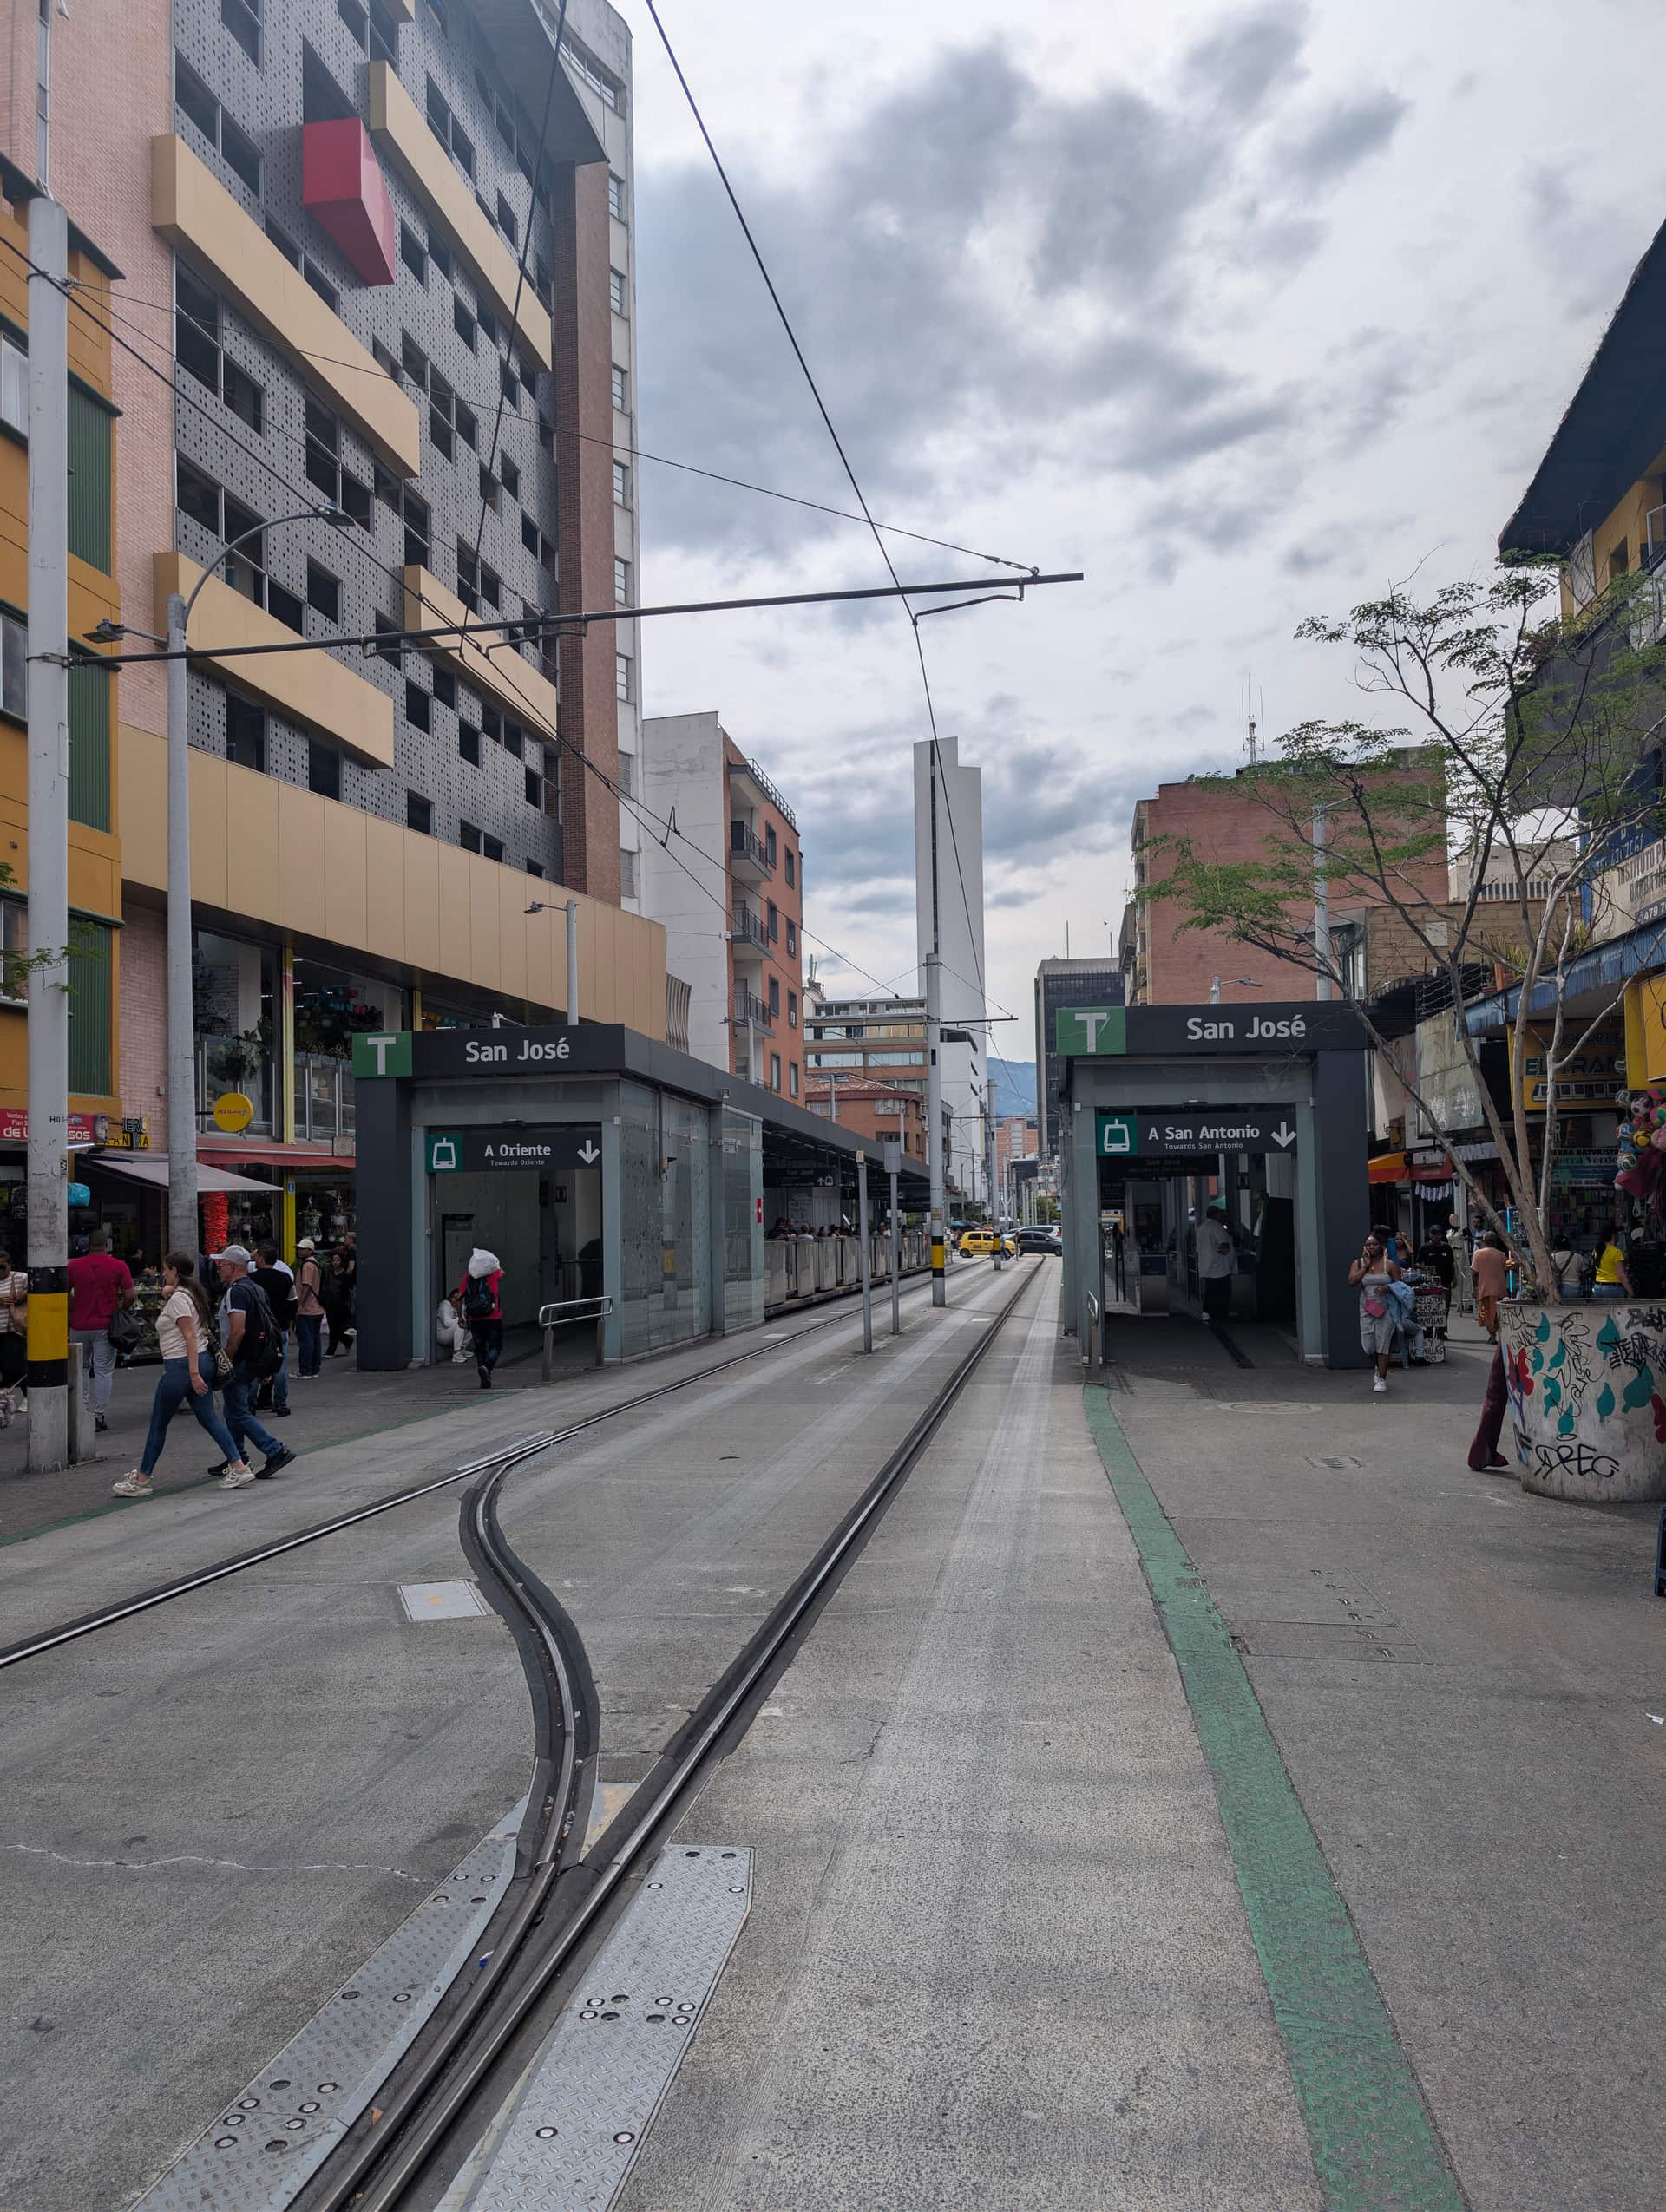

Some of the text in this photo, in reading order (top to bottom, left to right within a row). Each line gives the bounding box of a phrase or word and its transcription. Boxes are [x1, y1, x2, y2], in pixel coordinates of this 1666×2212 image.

[1618, 843, 1663, 887] INSTITUTO P
[1643, 905, 1659, 920] 479
[1075, 1012, 1109, 1053] T
[1186, 1013, 1307, 1040] San José
[367, 1037, 397, 1076] T
[465, 1037, 570, 1063] San José
[1526, 1056, 1549, 1077] EL
[1148, 1123, 1261, 1141] A San Antonio
[484, 1142, 552, 1157] A Oriente
